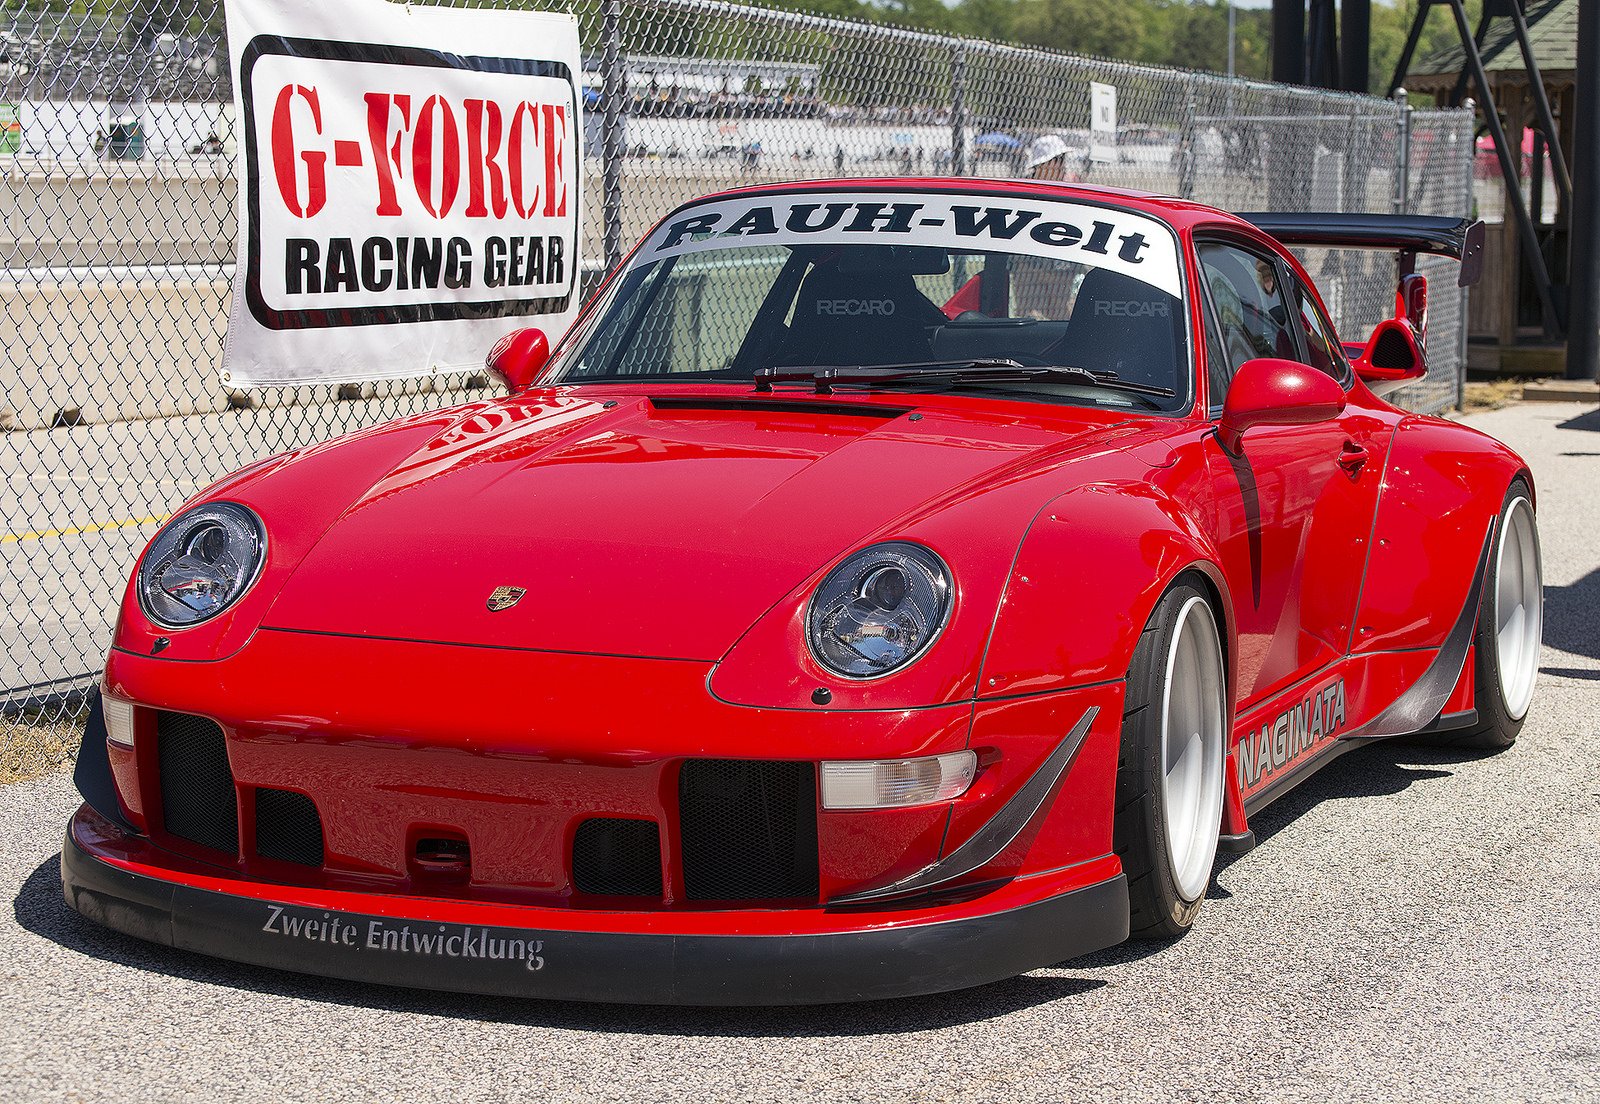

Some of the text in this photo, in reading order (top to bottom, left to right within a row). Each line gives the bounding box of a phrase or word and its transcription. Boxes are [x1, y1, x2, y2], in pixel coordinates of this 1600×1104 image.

[271, 84, 567, 220] G-FORCE
[285, 235, 565, 295] RACING GEAR
[656, 202, 1151, 264] RAUH-Welt
[816, 299, 896, 316] RECARO
[1238, 677, 1346, 794] NAGINATA
[262, 904, 545, 972] Zweite Entwicklung
